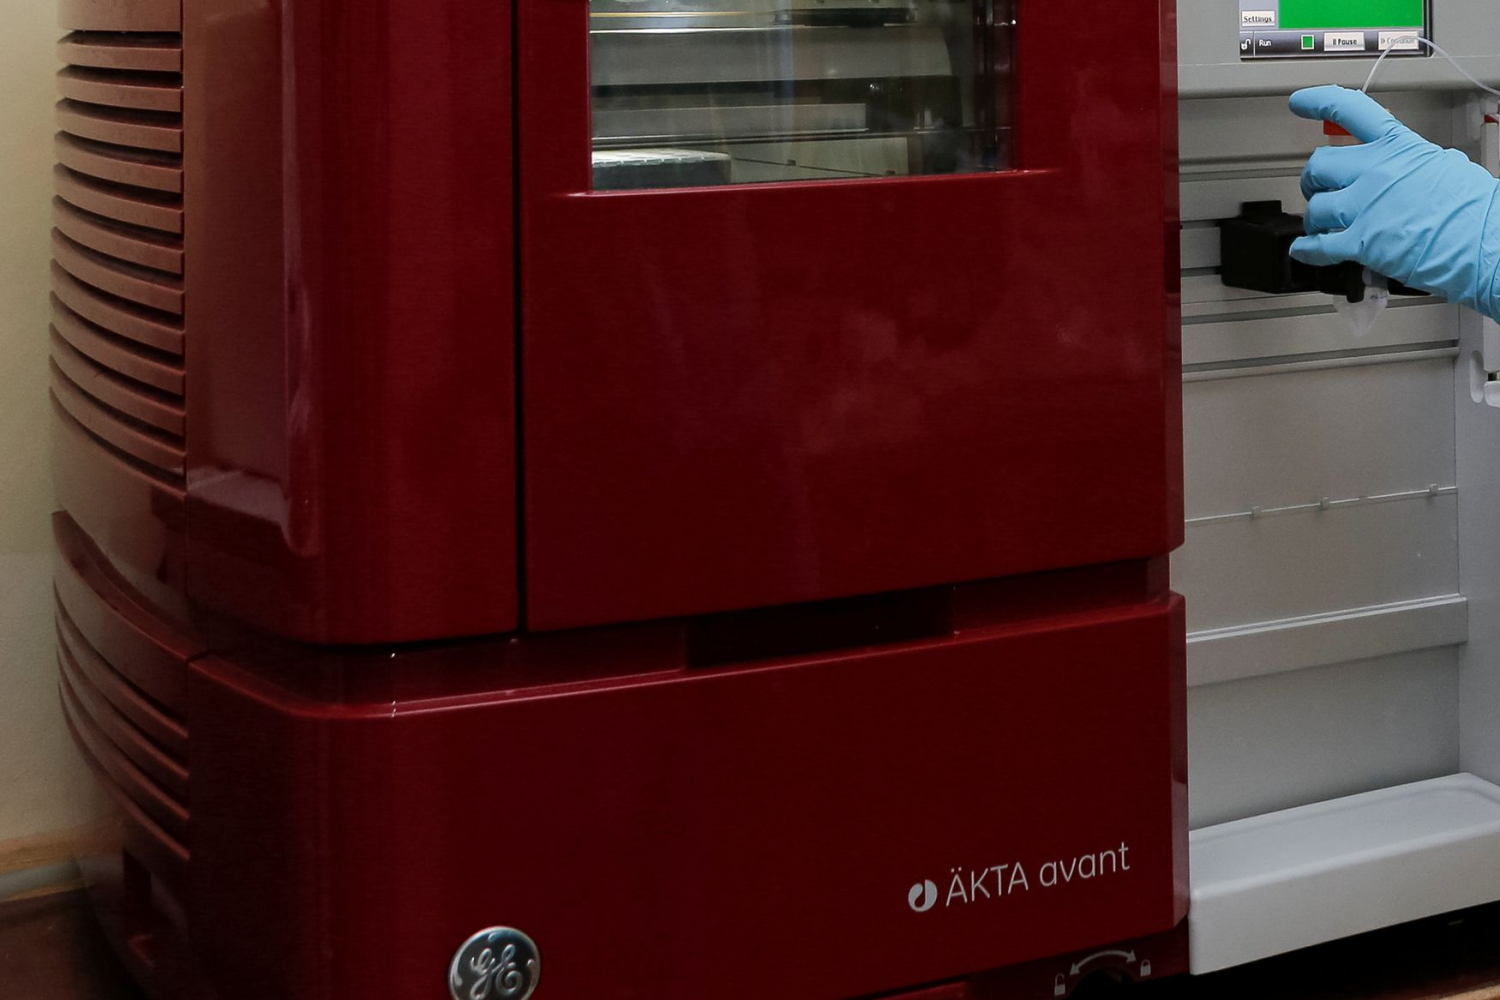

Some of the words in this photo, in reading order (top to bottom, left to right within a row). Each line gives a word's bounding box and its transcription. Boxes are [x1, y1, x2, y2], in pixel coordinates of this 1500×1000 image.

[1243, 15, 1272, 23] Settings
[1259, 39, 1272, 47] Run
[946, 867, 1029, 907] ÄKTA
[1039, 842, 1131, 887] avant
